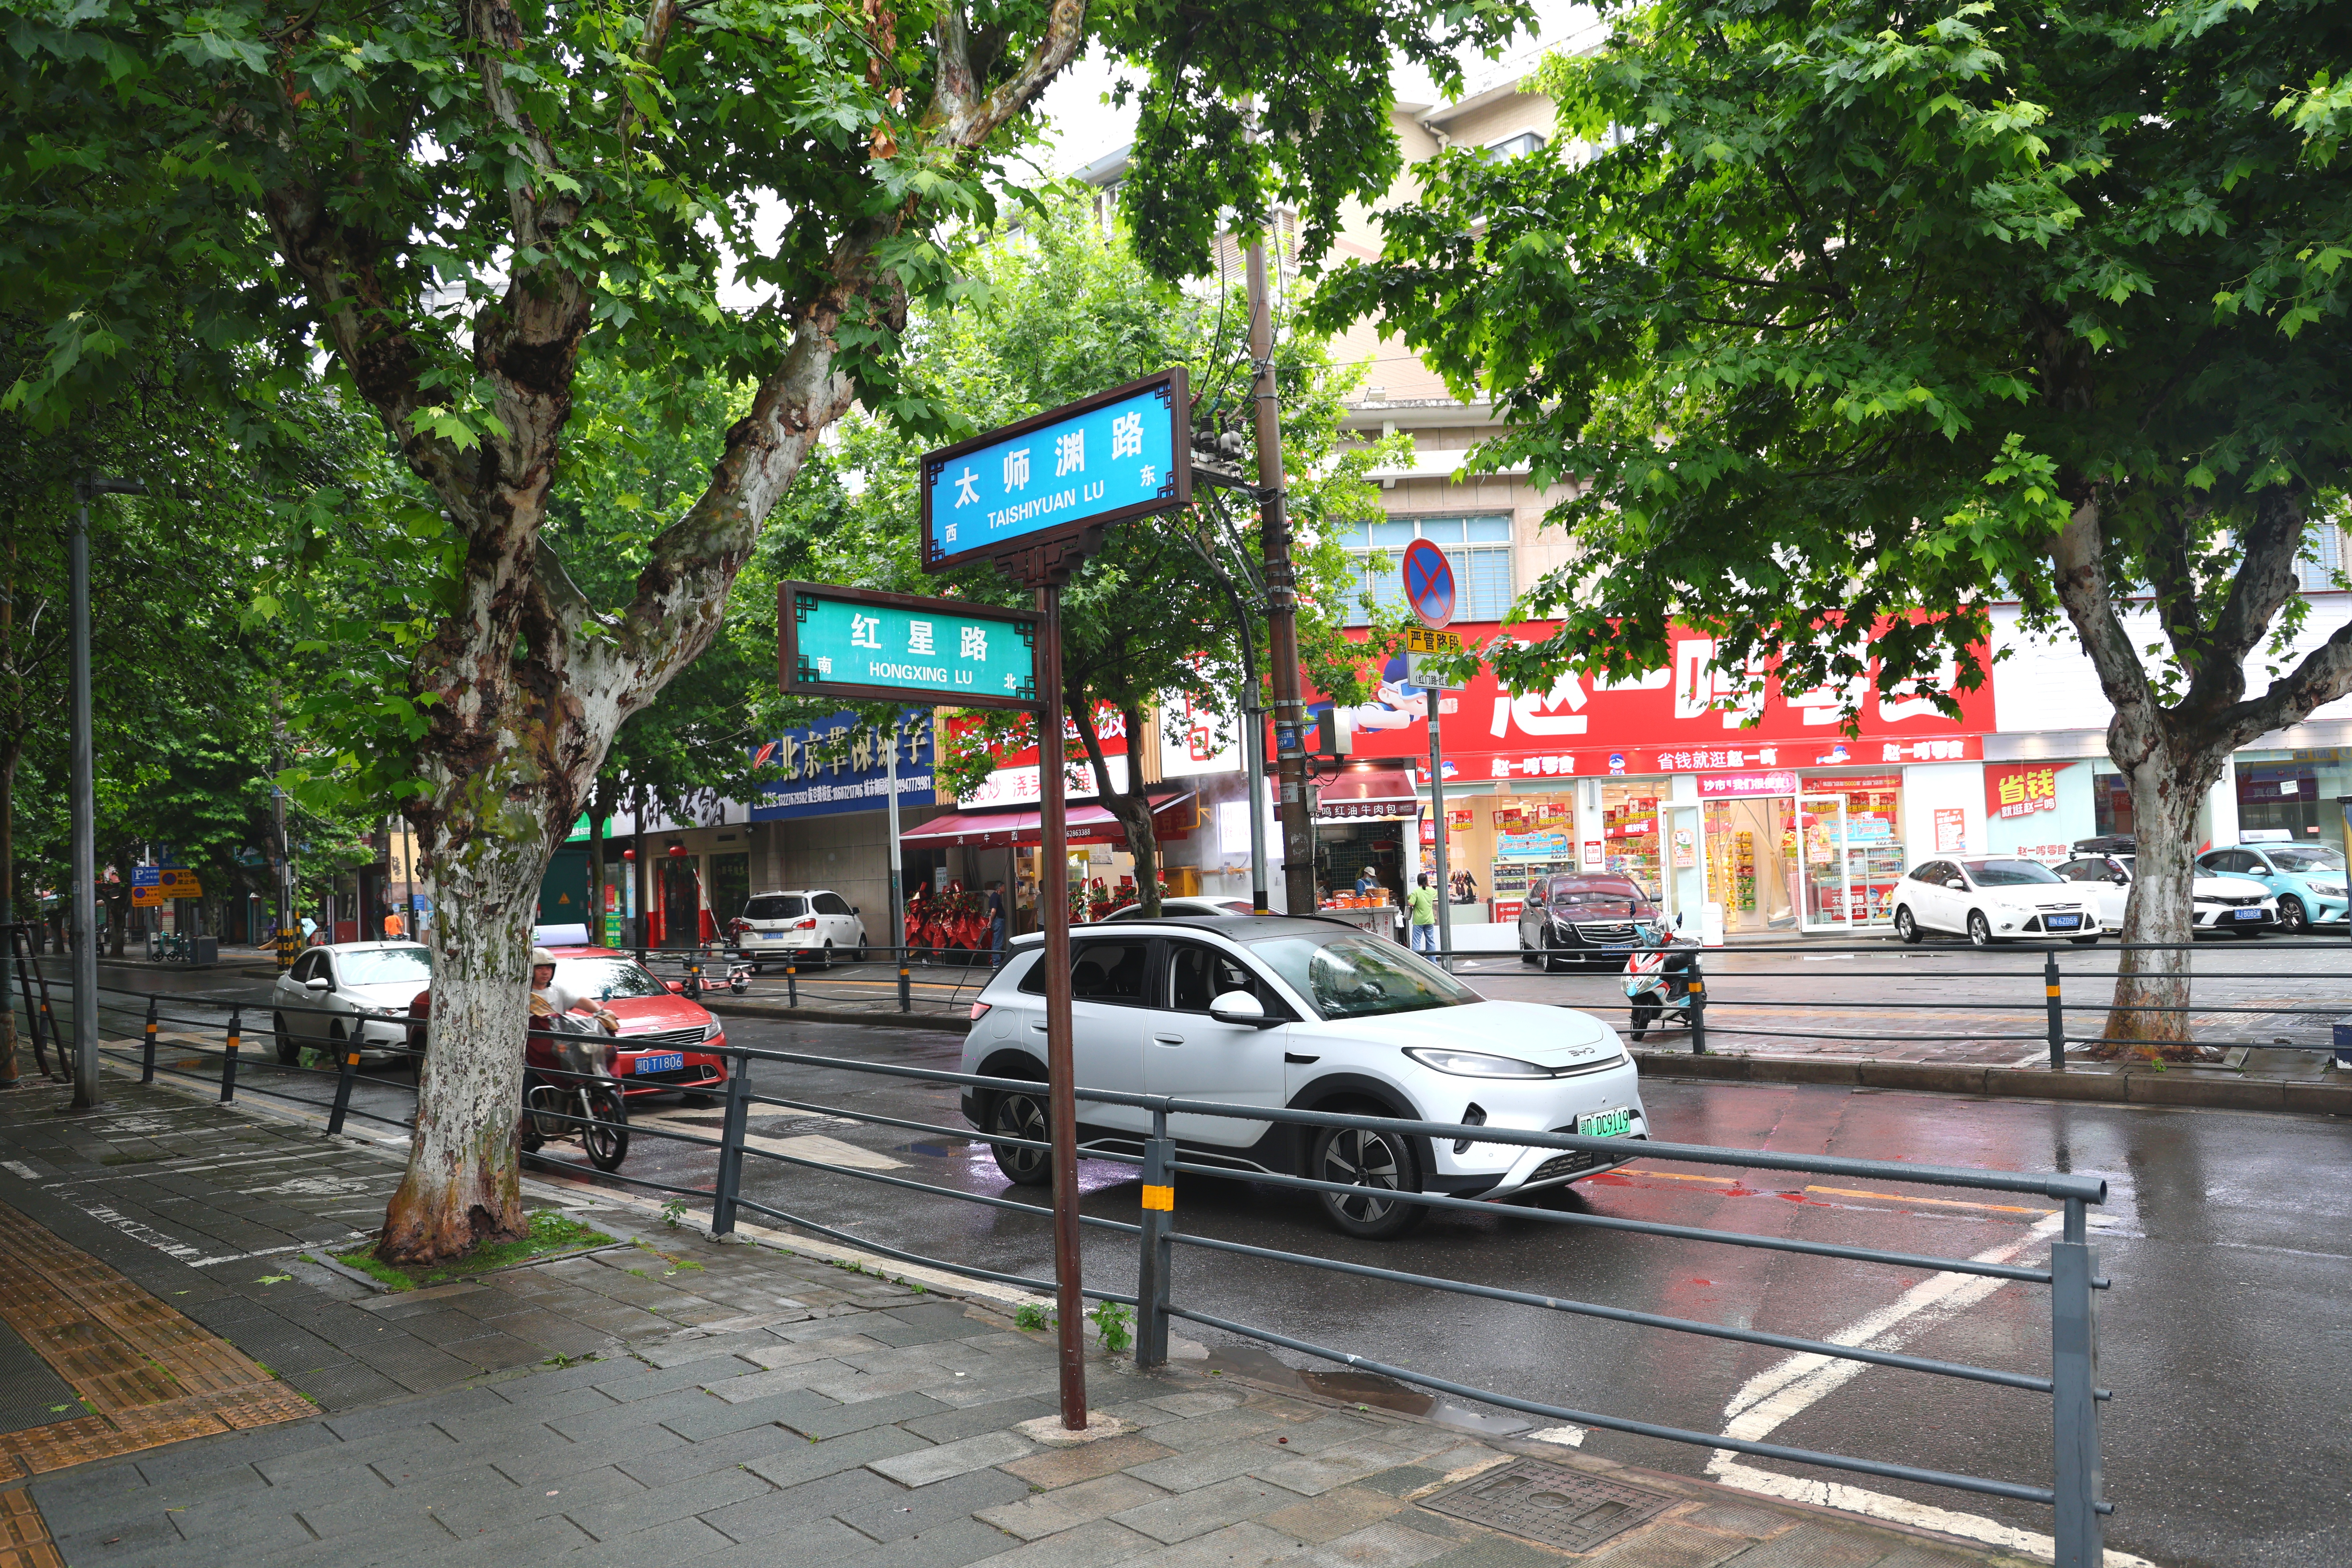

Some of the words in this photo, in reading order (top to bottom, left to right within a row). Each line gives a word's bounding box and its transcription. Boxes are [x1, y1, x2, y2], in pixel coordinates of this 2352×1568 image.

[955, 412, 1144, 508] 太师渊路
[1140, 465, 1156, 486] 东
[987, 493, 1076, 529] TAISHIYUAN
[1083, 480, 1104, 502] LU
[945, 523, 958, 543] 西
[851, 613, 988, 661] 红星路
[1411, 631, 1459, 652] 严管路段
[817, 656, 832, 674] 南
[870, 662, 947, 682] HONGXING
[955, 669, 972, 684] LU
[1004, 673, 1016, 689] 北
[1492, 756, 1575, 777] 赵一鸣零食
[1657, 748, 1778, 770] 省钱就逛赵一鸣
[1999, 768, 2055, 804] 省钱
[2002, 798, 2055, 818] 就逛赵一鸣
[1625, 824, 1649, 833] 超好吃
[2017, 844, 2067, 856] 赵一鸣零食
[134, 870, 143, 879] P
[1568, 1047, 1595, 1057] BYD
